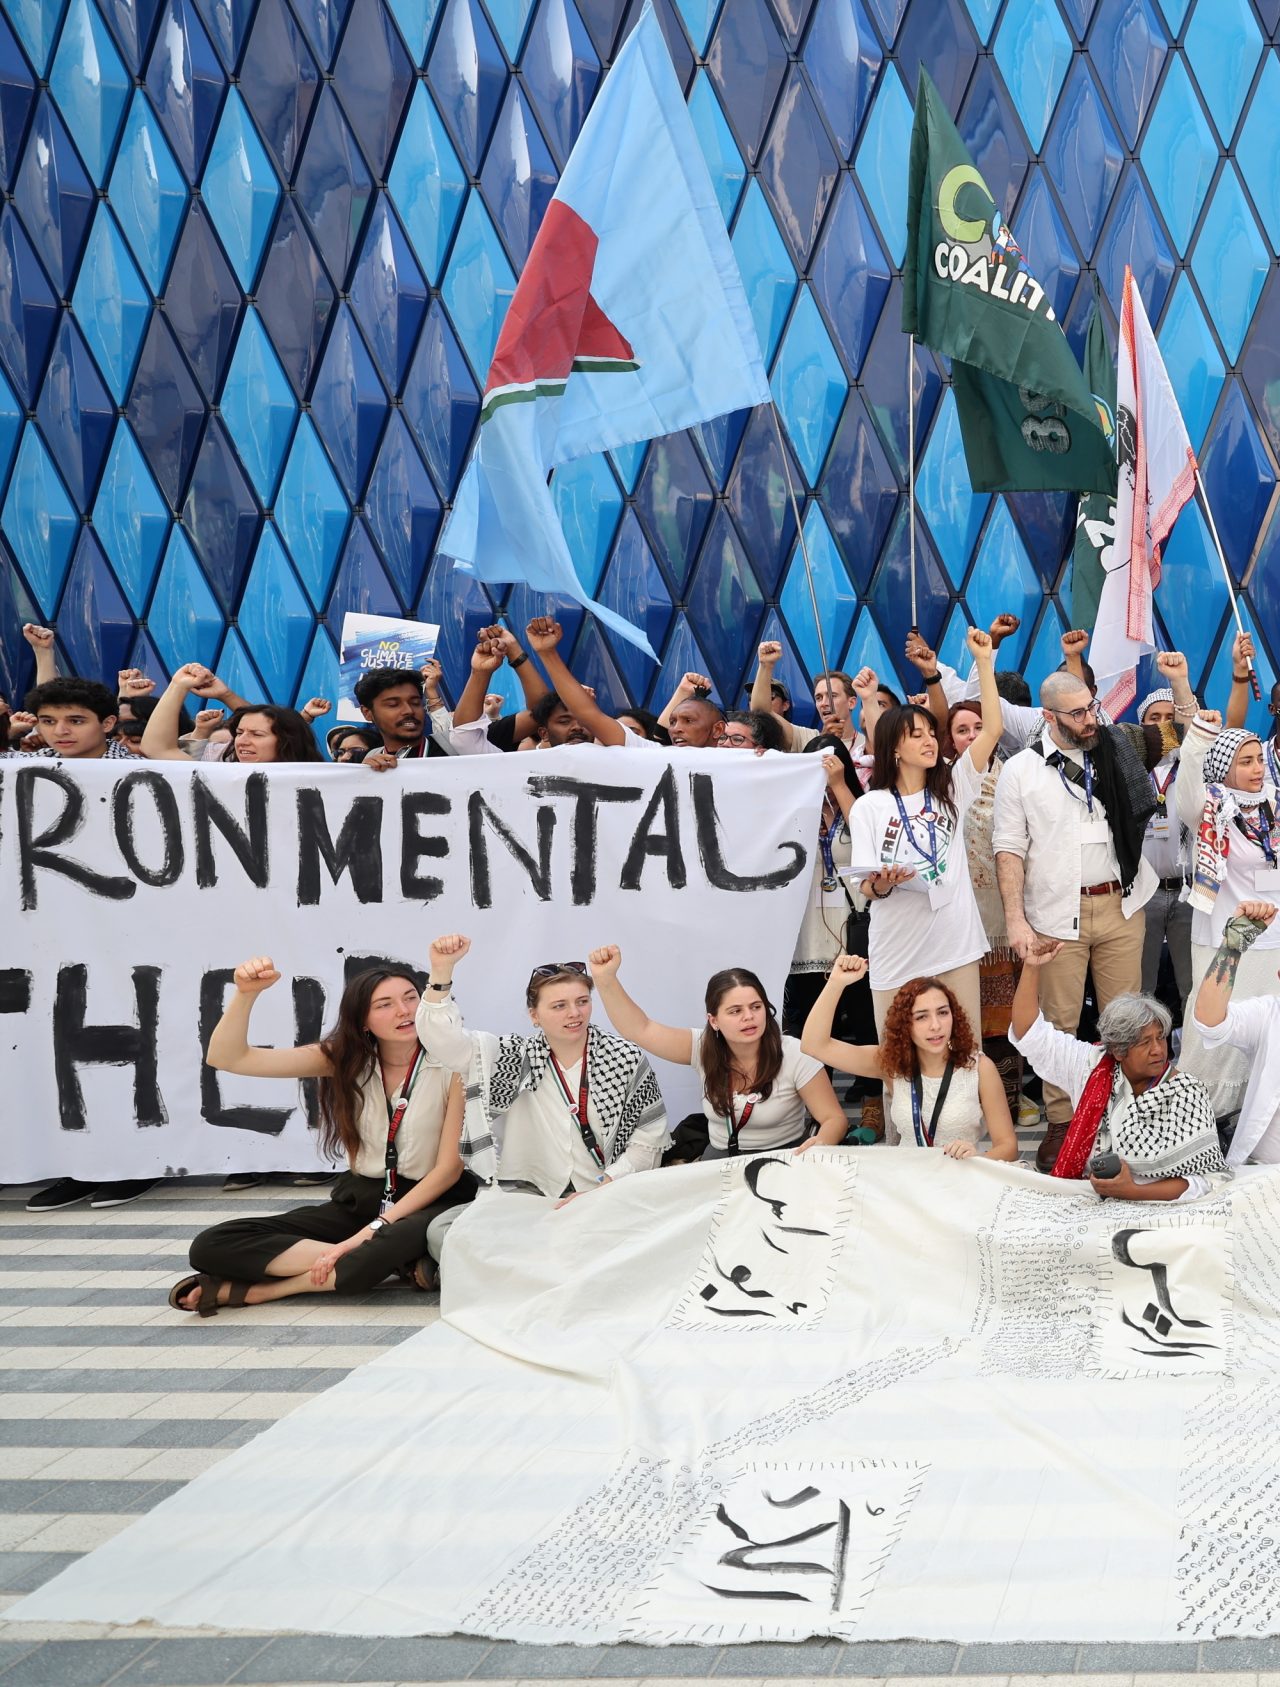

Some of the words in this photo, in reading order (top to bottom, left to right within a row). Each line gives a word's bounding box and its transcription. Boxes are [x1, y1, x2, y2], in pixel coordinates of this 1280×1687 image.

[379, 641, 400, 651] NO
[361, 649, 413, 662] CLIMATE
[361, 657, 413, 671] JUSTICE
[0, 762, 807, 912] RONMENTAL
[881, 816, 902, 863] FREE
